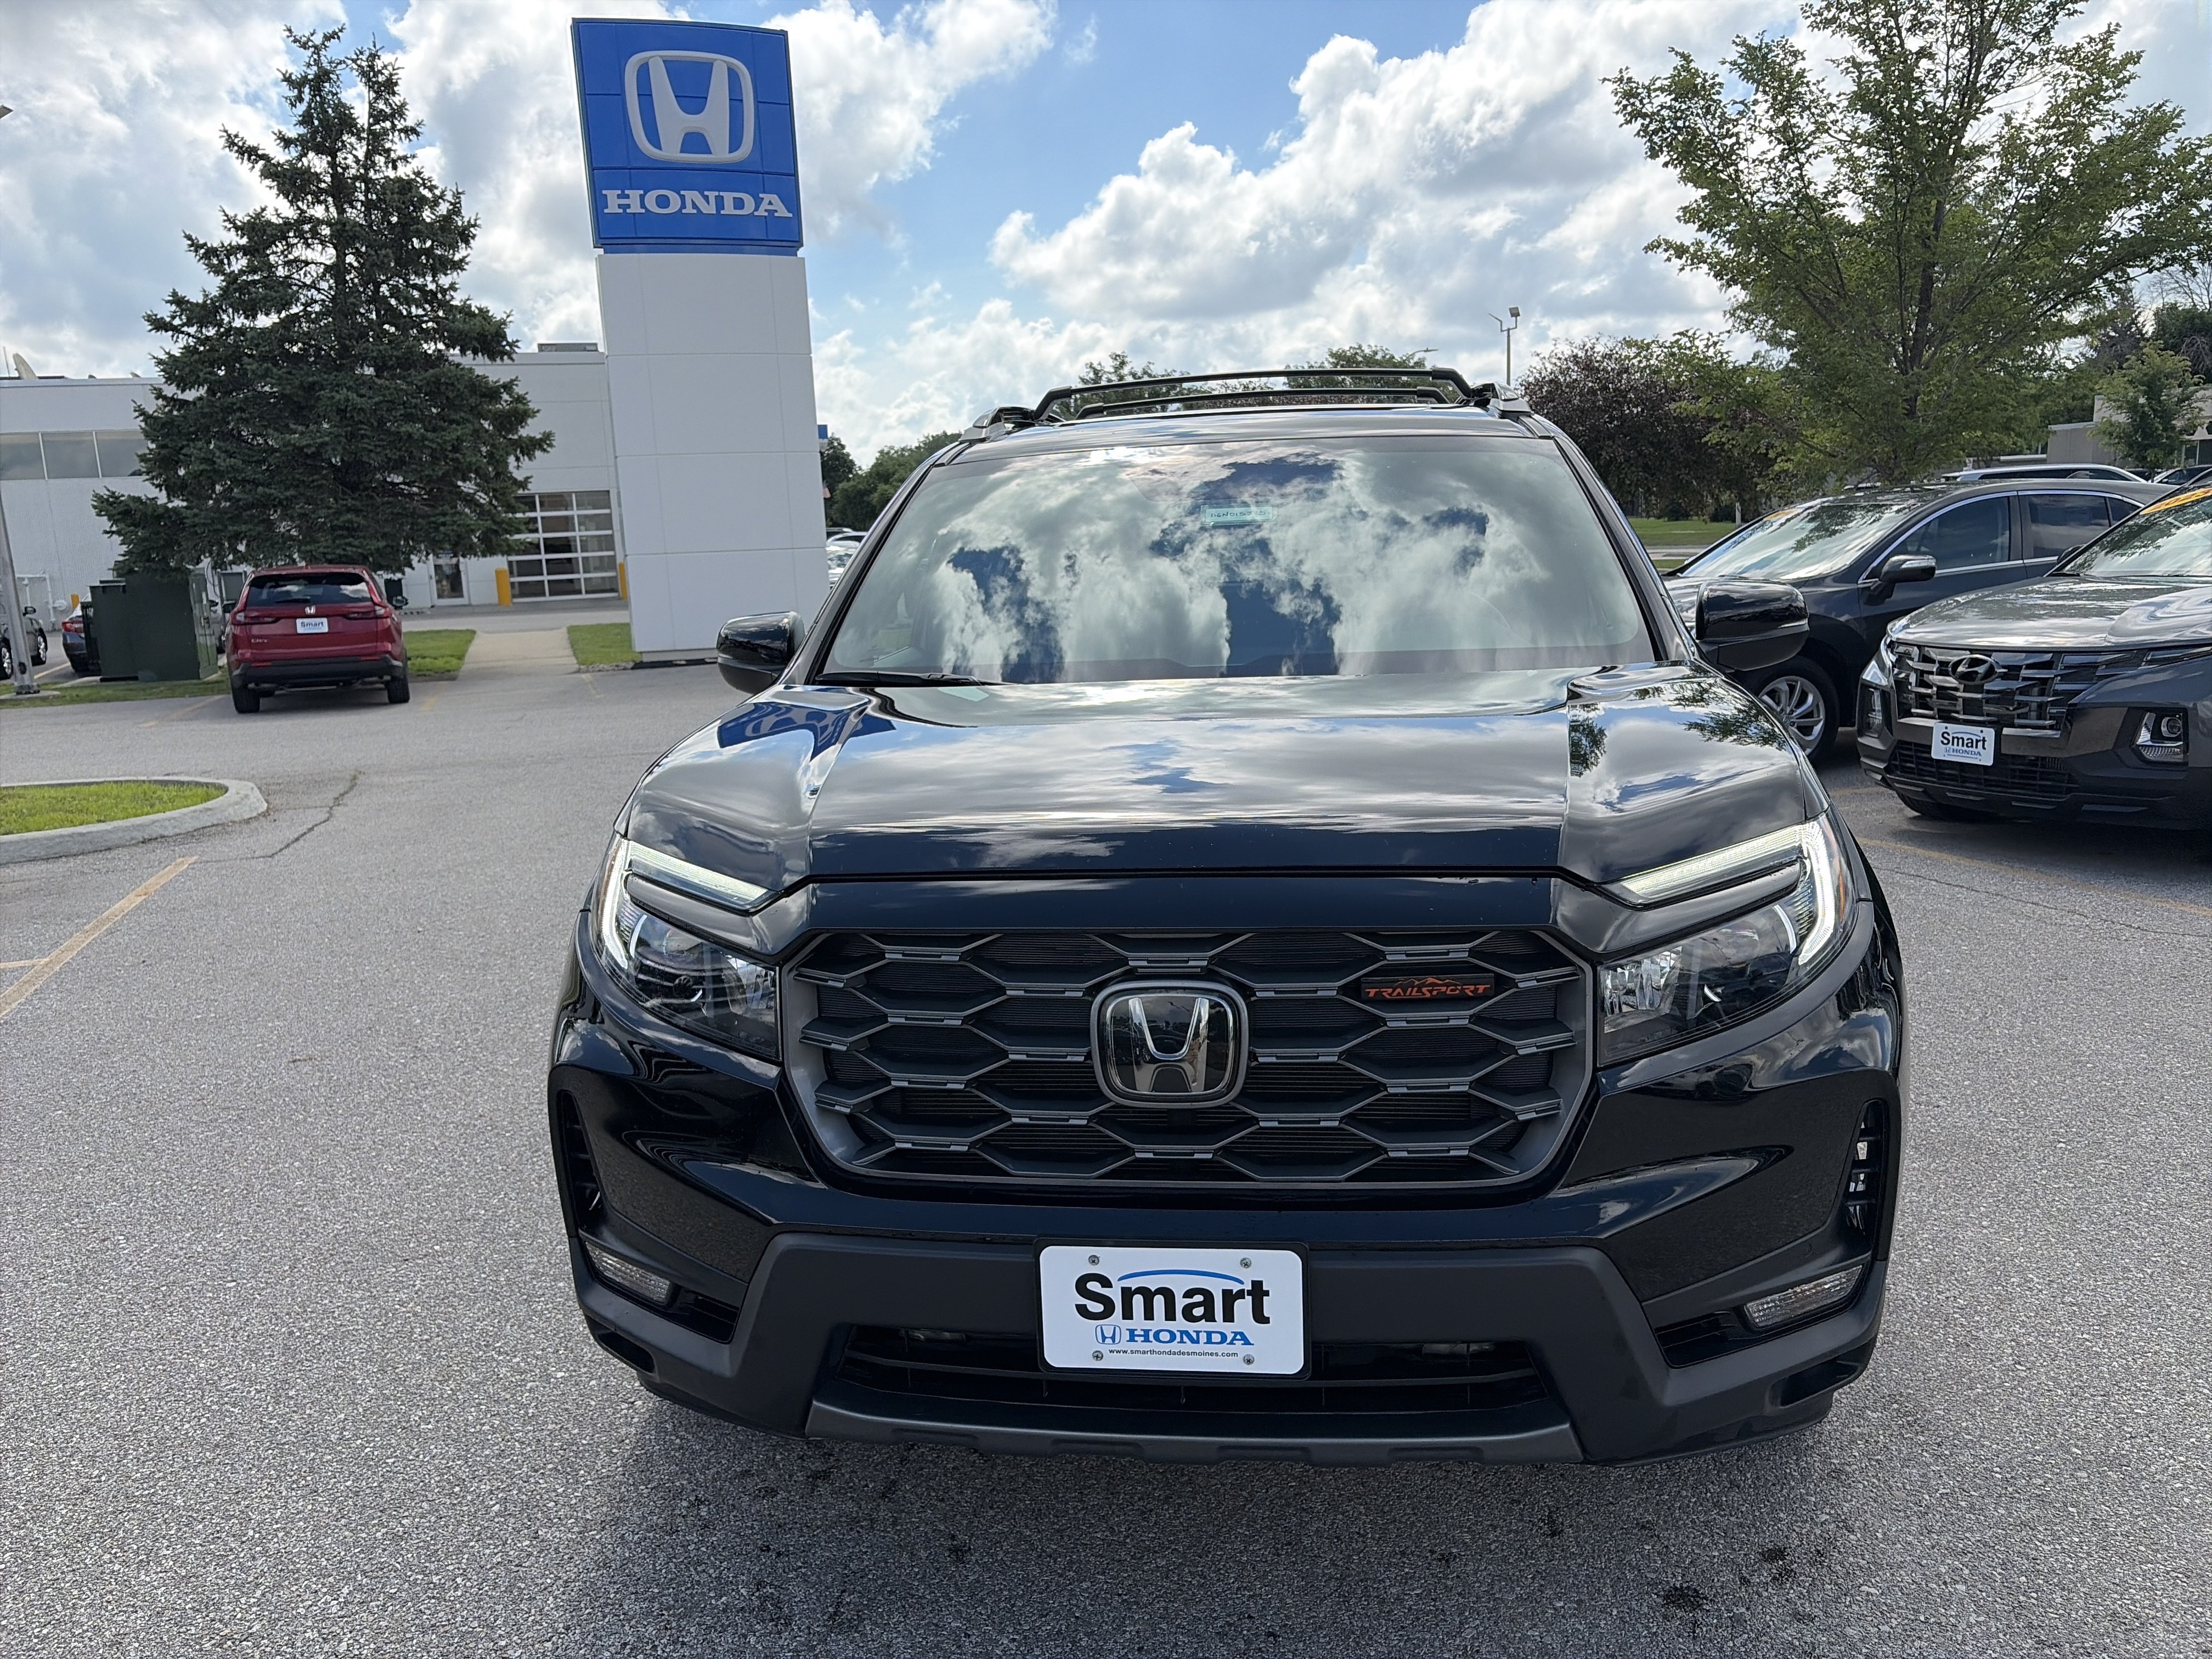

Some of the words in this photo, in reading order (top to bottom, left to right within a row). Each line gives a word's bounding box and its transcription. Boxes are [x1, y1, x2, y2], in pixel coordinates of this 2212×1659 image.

[602, 190, 793, 218] HONDA
[1940, 731, 1987, 750] Smart
[1952, 748, 1982, 756] HONDA
[1364, 985, 1491, 998] TRAILSPORT
[1074, 1273, 1271, 1325] Smart
[1126, 1328, 1254, 1346] HONDA
[1109, 1348, 1238, 1358] www.smarthondadesmoines.com
